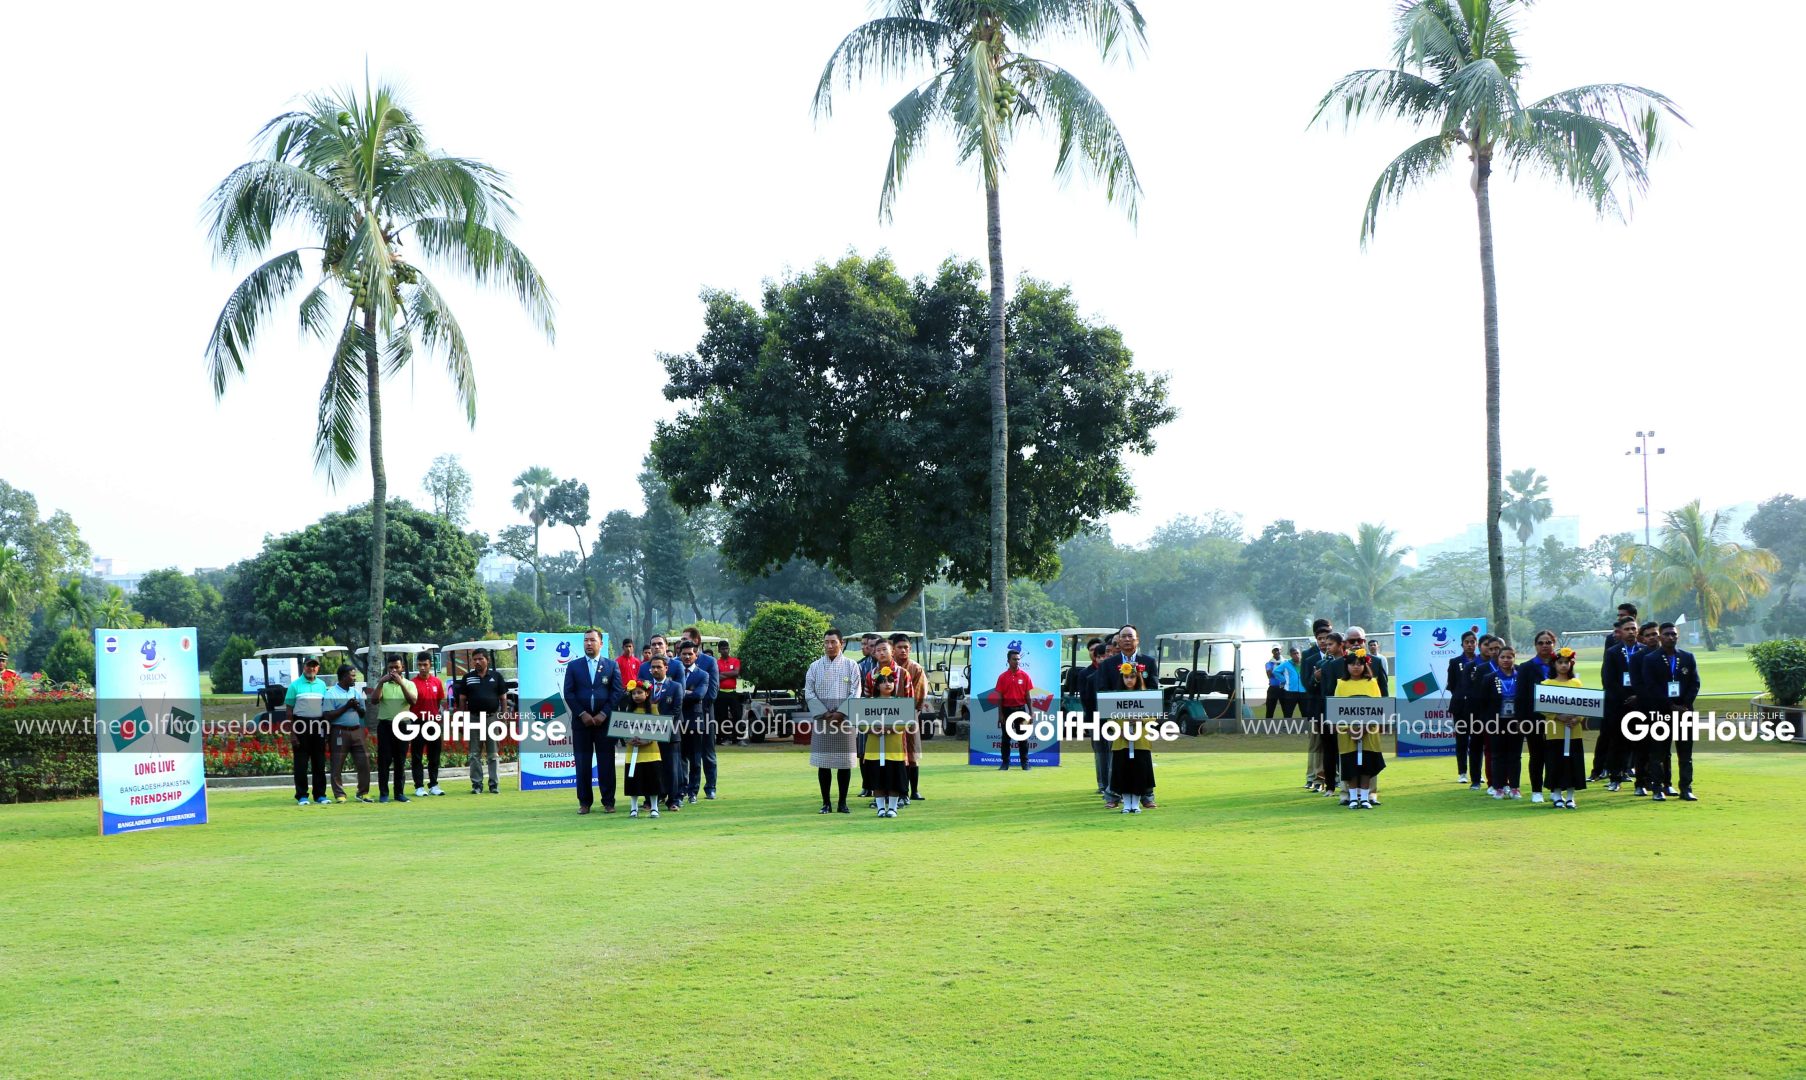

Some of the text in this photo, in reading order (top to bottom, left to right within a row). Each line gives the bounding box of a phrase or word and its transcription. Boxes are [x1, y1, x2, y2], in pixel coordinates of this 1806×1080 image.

[139, 672, 167, 681] ORION
[1116, 700, 1145, 710] NEPAL
[1539, 694, 1601, 708] BANGLADESH
[864, 707, 900, 716] BHUTAN
[1338, 706, 1384, 716] PAKISTAN
[134, 760, 176, 776] LONG LIVE
[543, 760, 576, 769] FRIENDS
[119, 779, 191, 794] BANGLADESH-PAKISTAN
[130, 790, 182, 806] FRIENDSHIP
[117, 812, 196, 829] BANGLADESH GOLF FEDERATION
